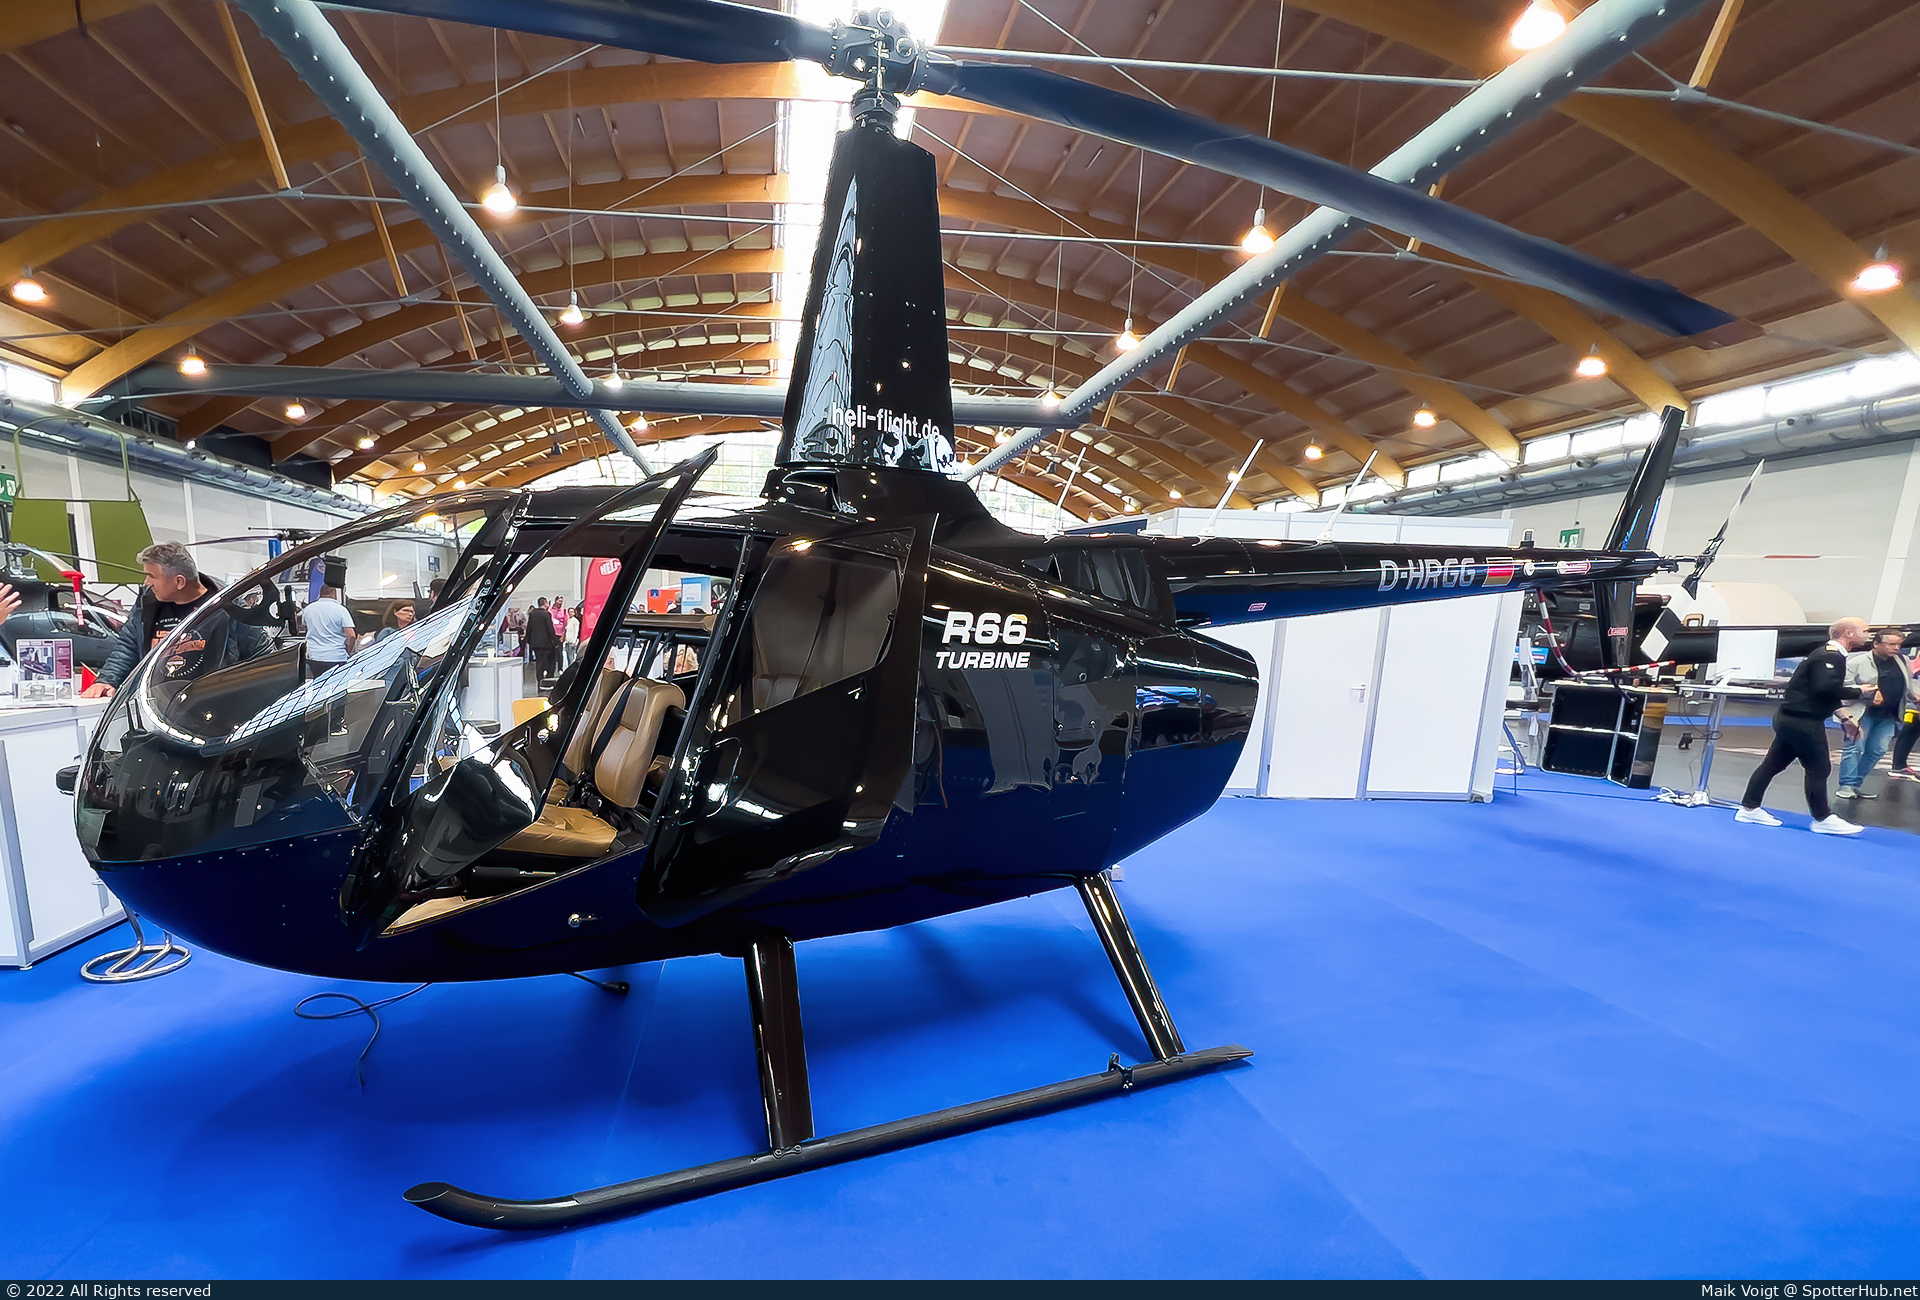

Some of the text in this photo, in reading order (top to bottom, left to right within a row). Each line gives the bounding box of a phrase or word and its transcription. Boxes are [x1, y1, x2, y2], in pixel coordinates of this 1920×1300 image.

[832, 401, 940, 441] heli-flight.de
[941, 611, 1028, 645] R66
[935, 651, 1031, 670] TURBINE
